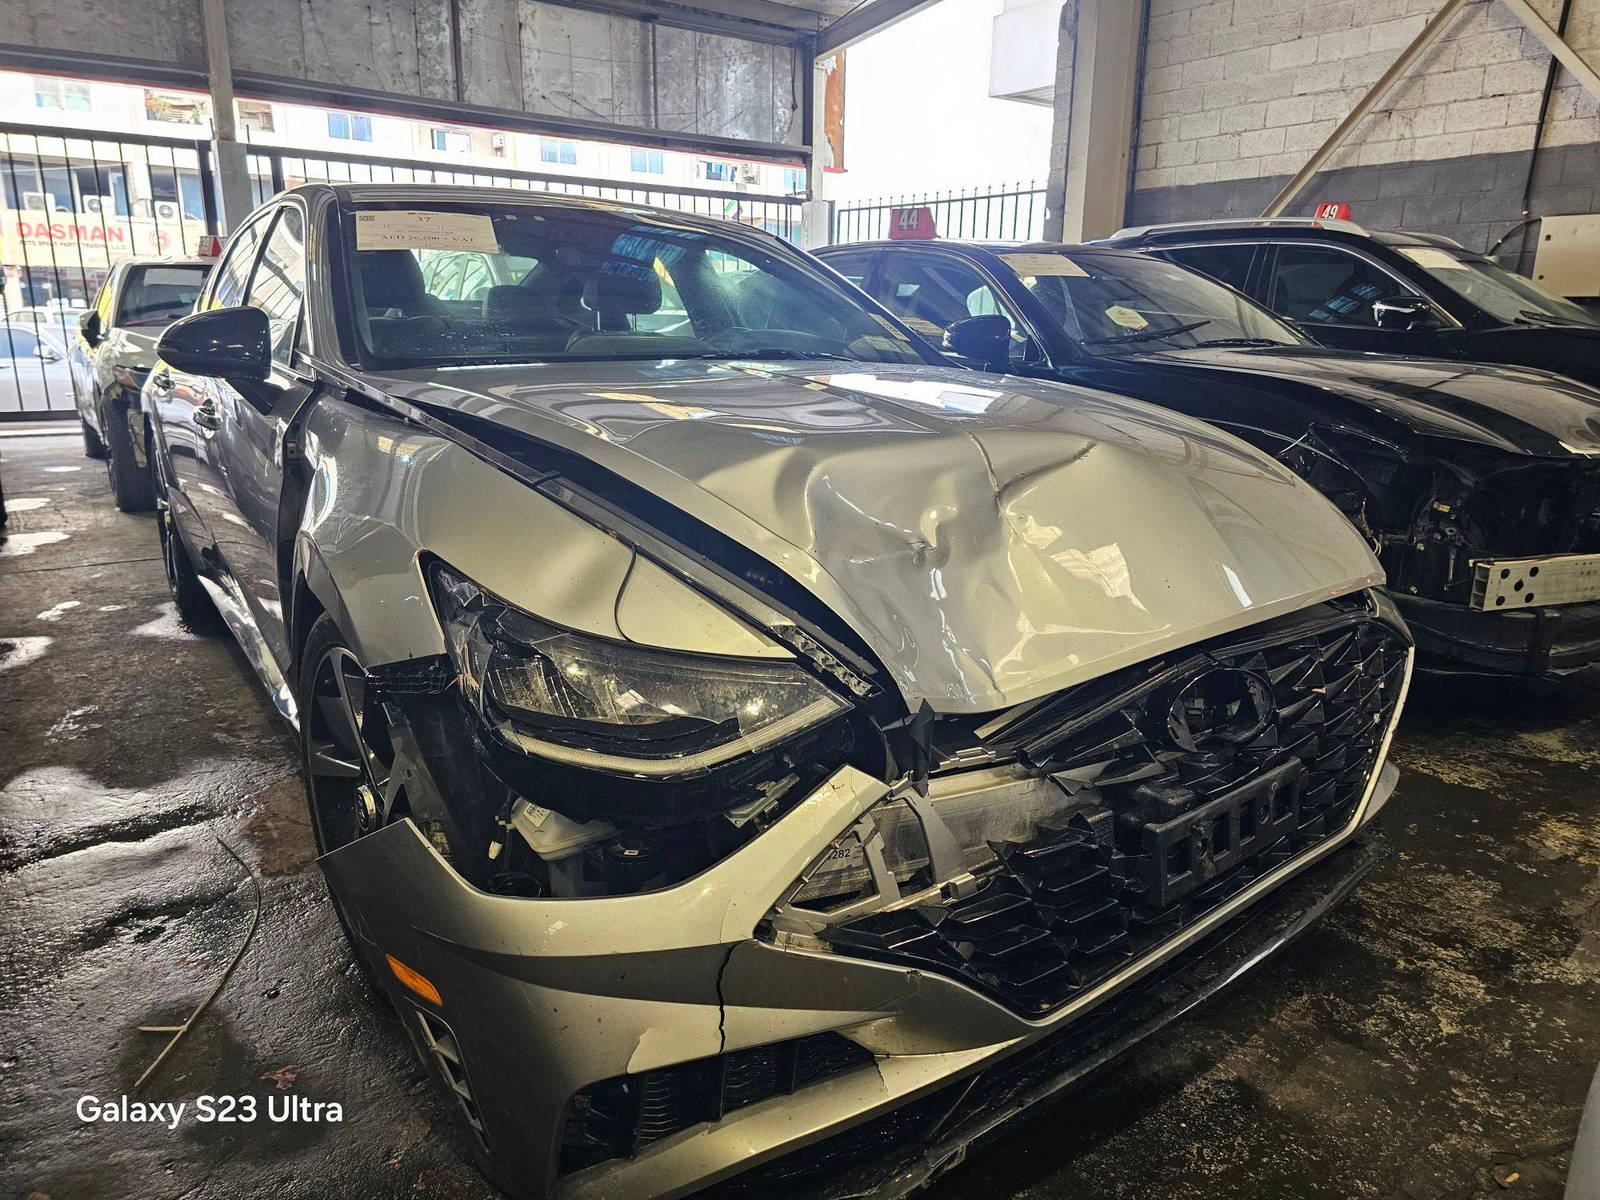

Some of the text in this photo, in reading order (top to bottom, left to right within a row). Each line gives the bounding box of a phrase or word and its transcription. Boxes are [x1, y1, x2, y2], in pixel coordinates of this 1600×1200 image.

[898, 208, 918, 230] 44
[1321, 204, 1339, 220] 49
[15, 221, 124, 243] DASMAN
